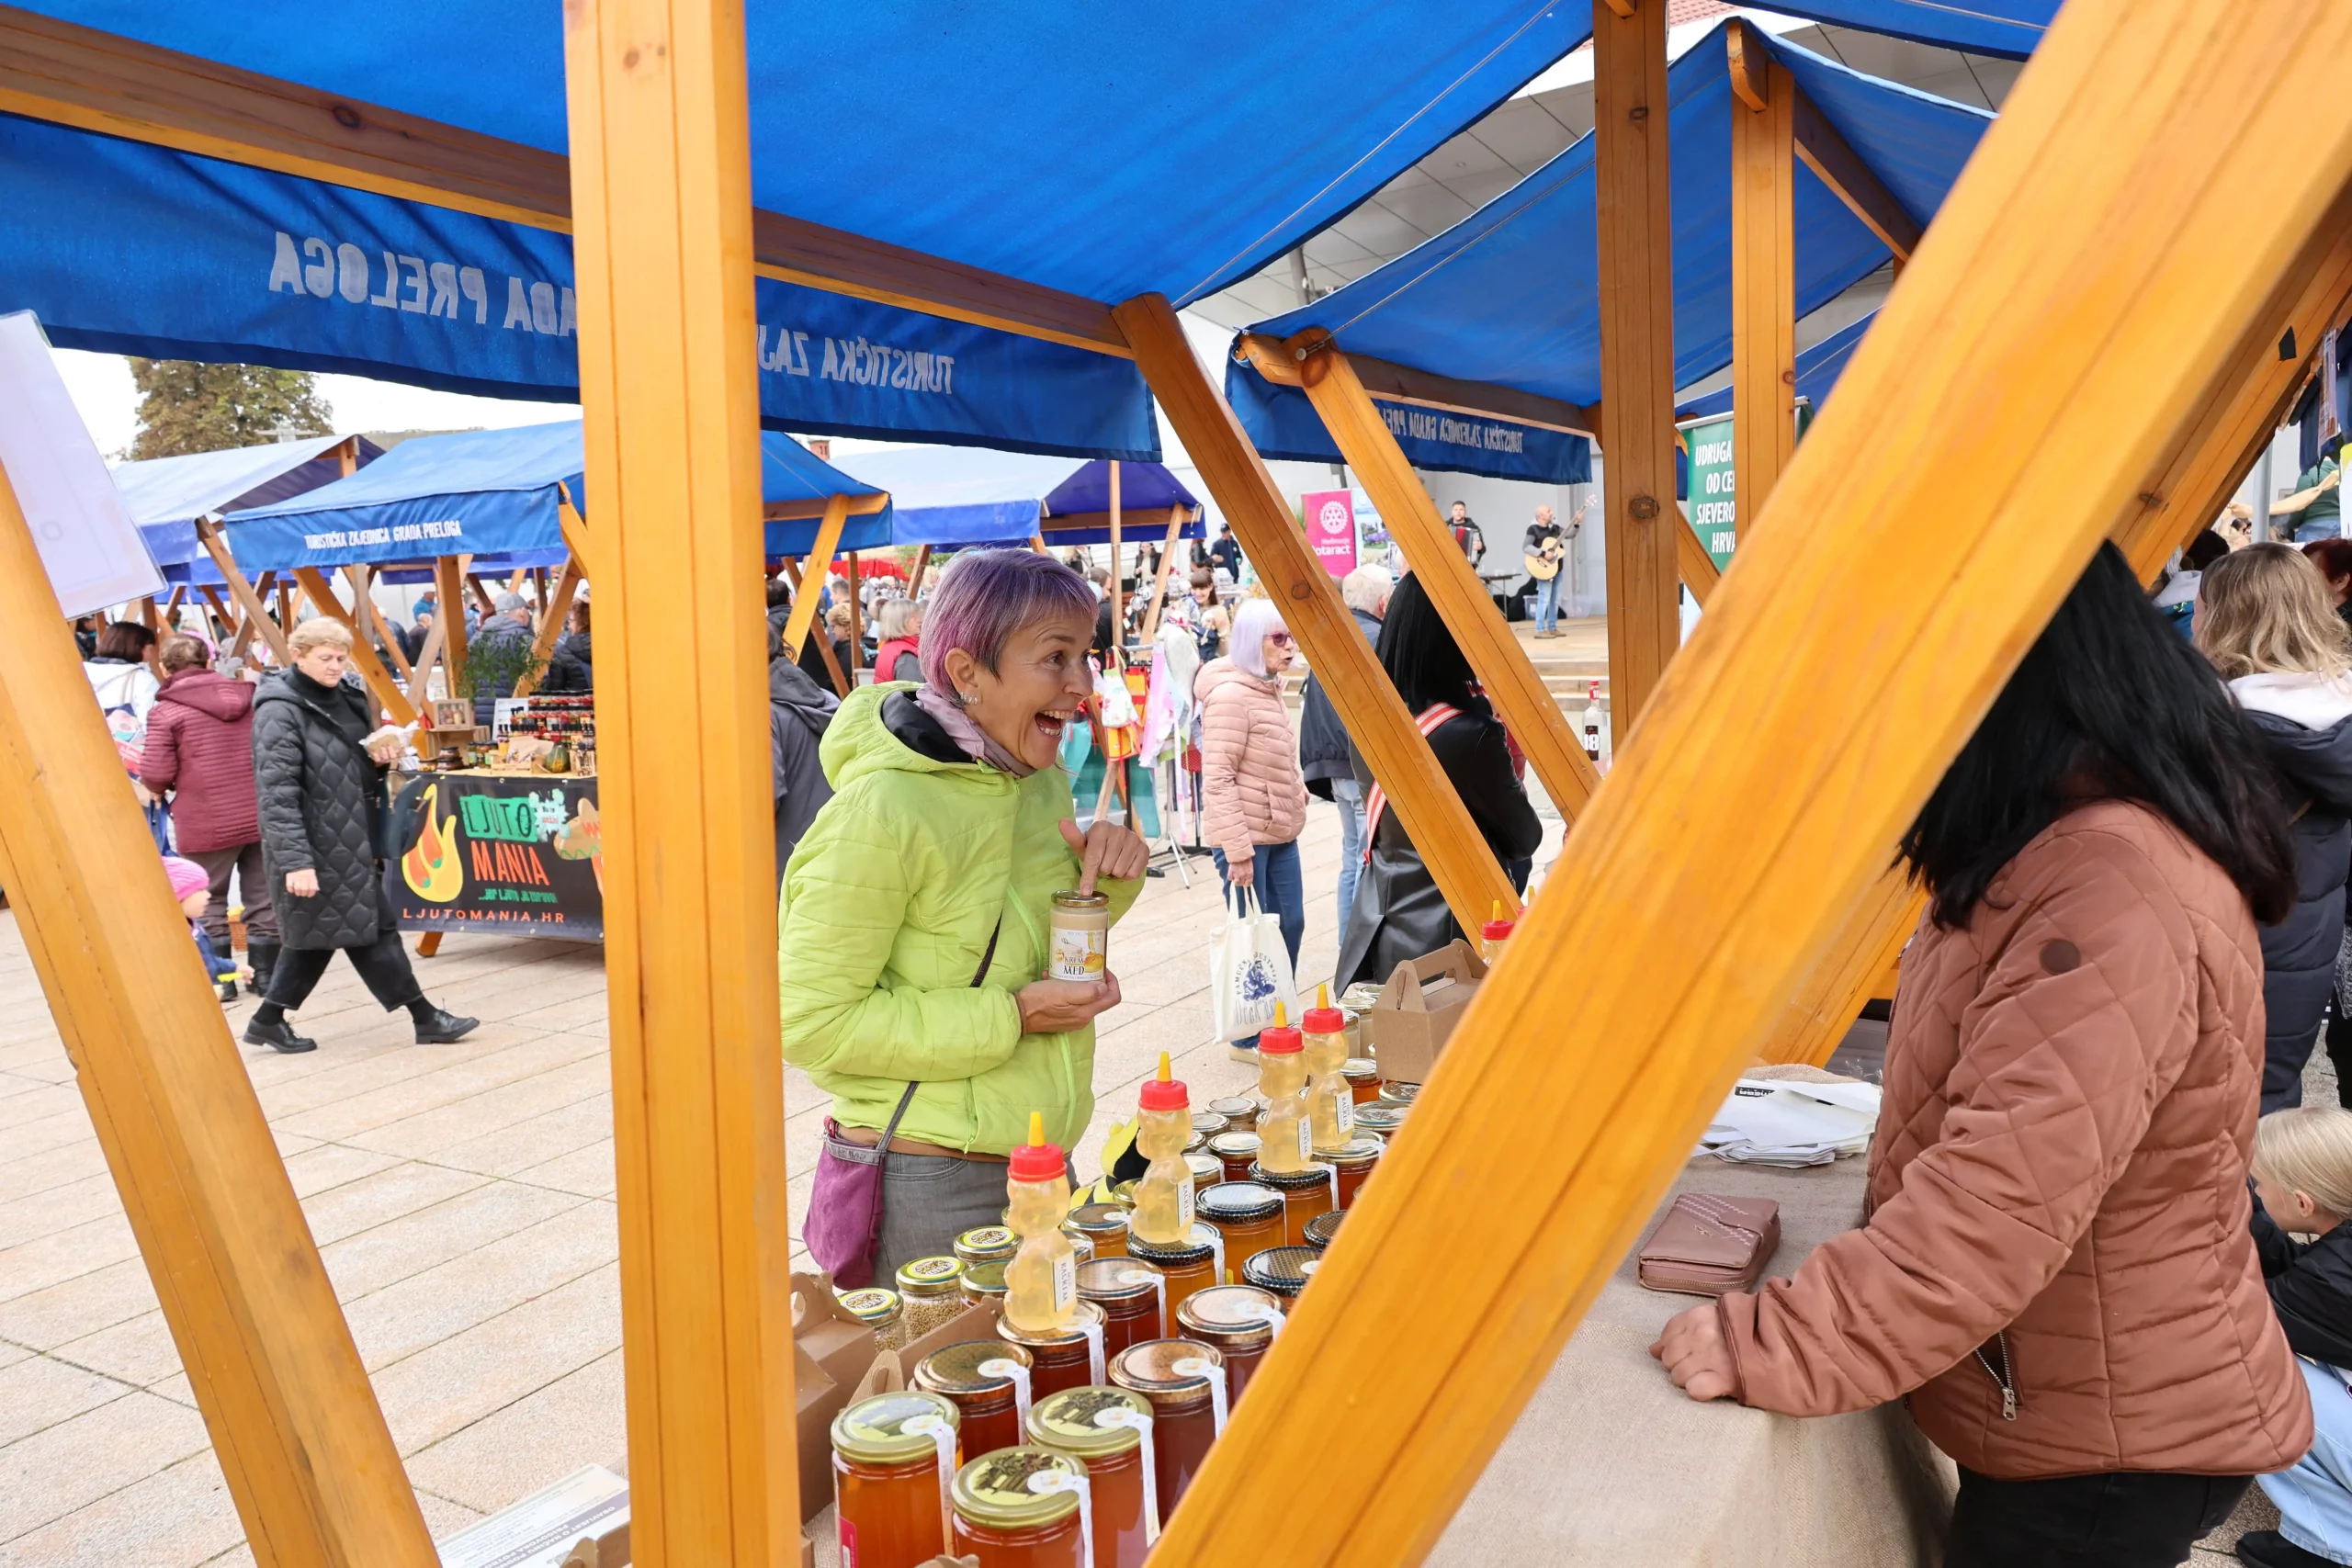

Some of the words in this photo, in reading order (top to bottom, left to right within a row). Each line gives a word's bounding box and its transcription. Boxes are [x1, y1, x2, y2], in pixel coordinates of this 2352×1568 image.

[1695, 440, 1732, 467] UDRUGA
[1706, 472, 1720, 494] OD
[1696, 500, 1735, 525] SJEVERO
[304, 530, 347, 549] TURISTIČKA
[348, 526, 390, 547] ZAJEDNICA
[393, 524, 422, 541] GRADA
[423, 520, 462, 538] PRELOGA
[1712, 530, 1735, 553] HRVA
[1584, 734, 1600, 751] 18
[464, 800, 532, 838] LJUTO
[470, 840, 549, 886] MANIA
[402, 908, 565, 923] LJUTOMANIA.HR
[1063, 964, 1085, 975] MED
